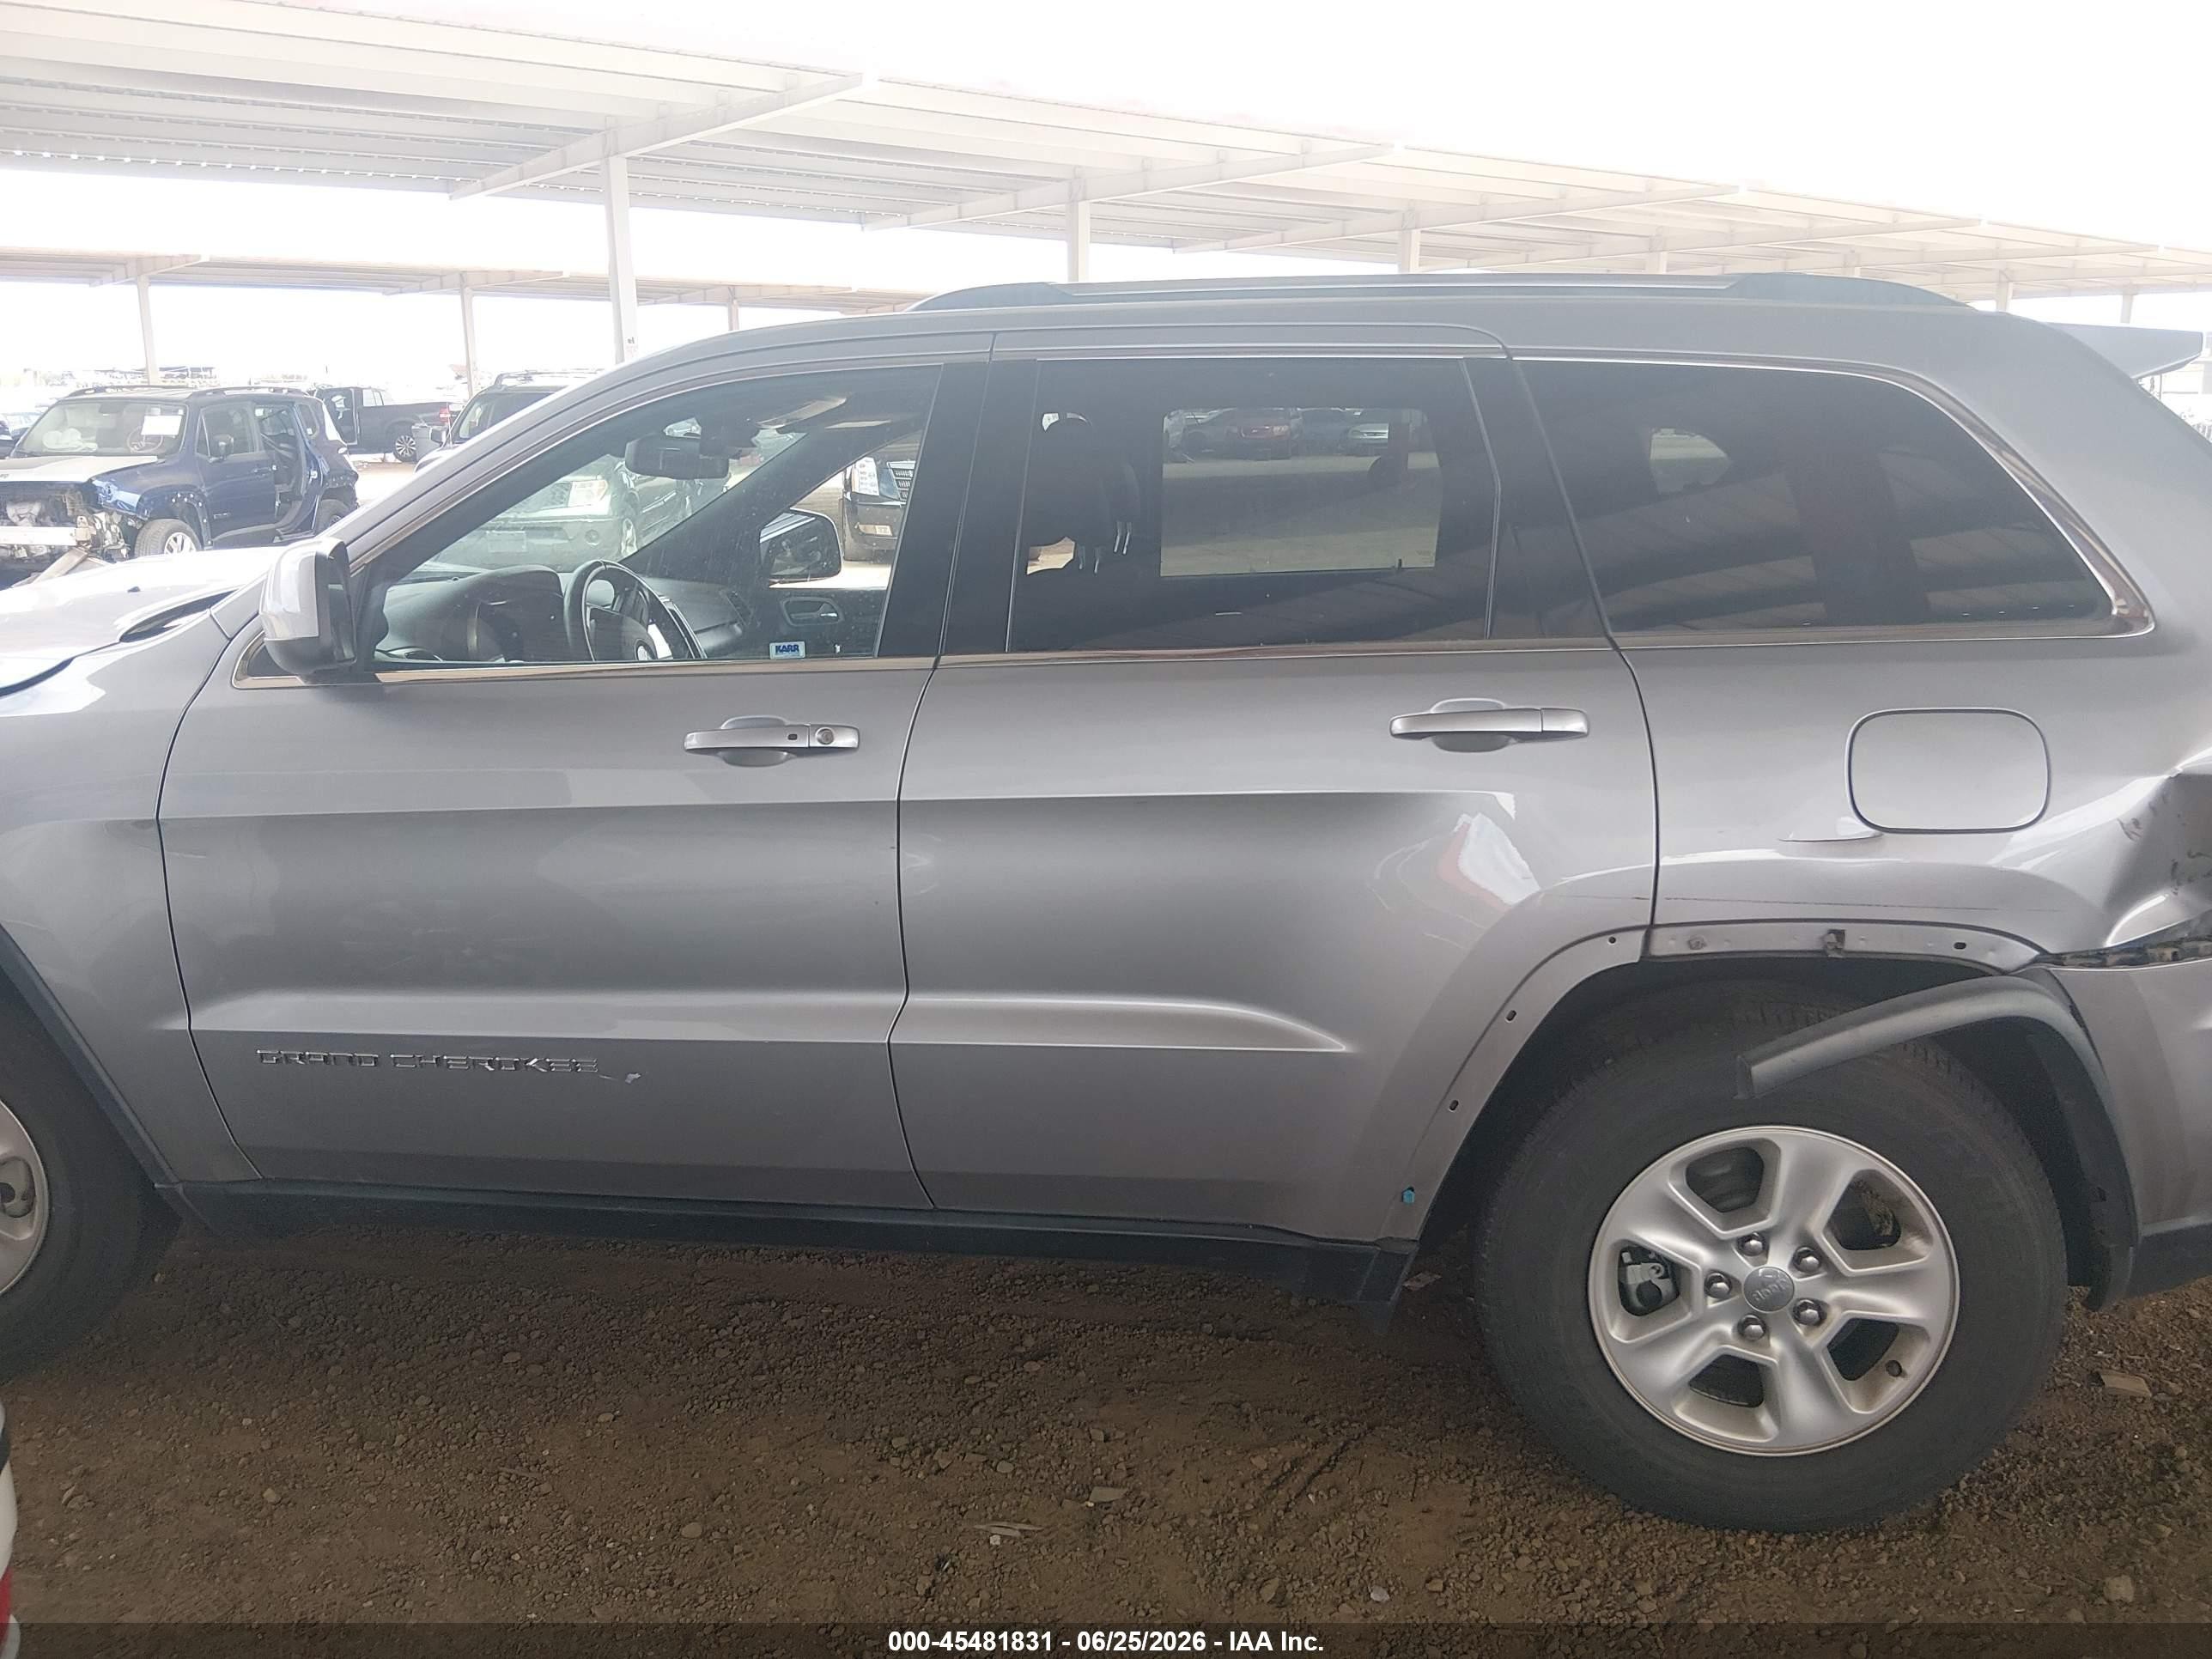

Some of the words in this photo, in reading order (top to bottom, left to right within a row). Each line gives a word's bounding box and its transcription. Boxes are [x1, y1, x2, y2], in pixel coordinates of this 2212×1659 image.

[775, 644, 799, 653] KARR
[257, 1049, 379, 1066] GRAND
[390, 1054, 599, 1073] CHEROKEE
